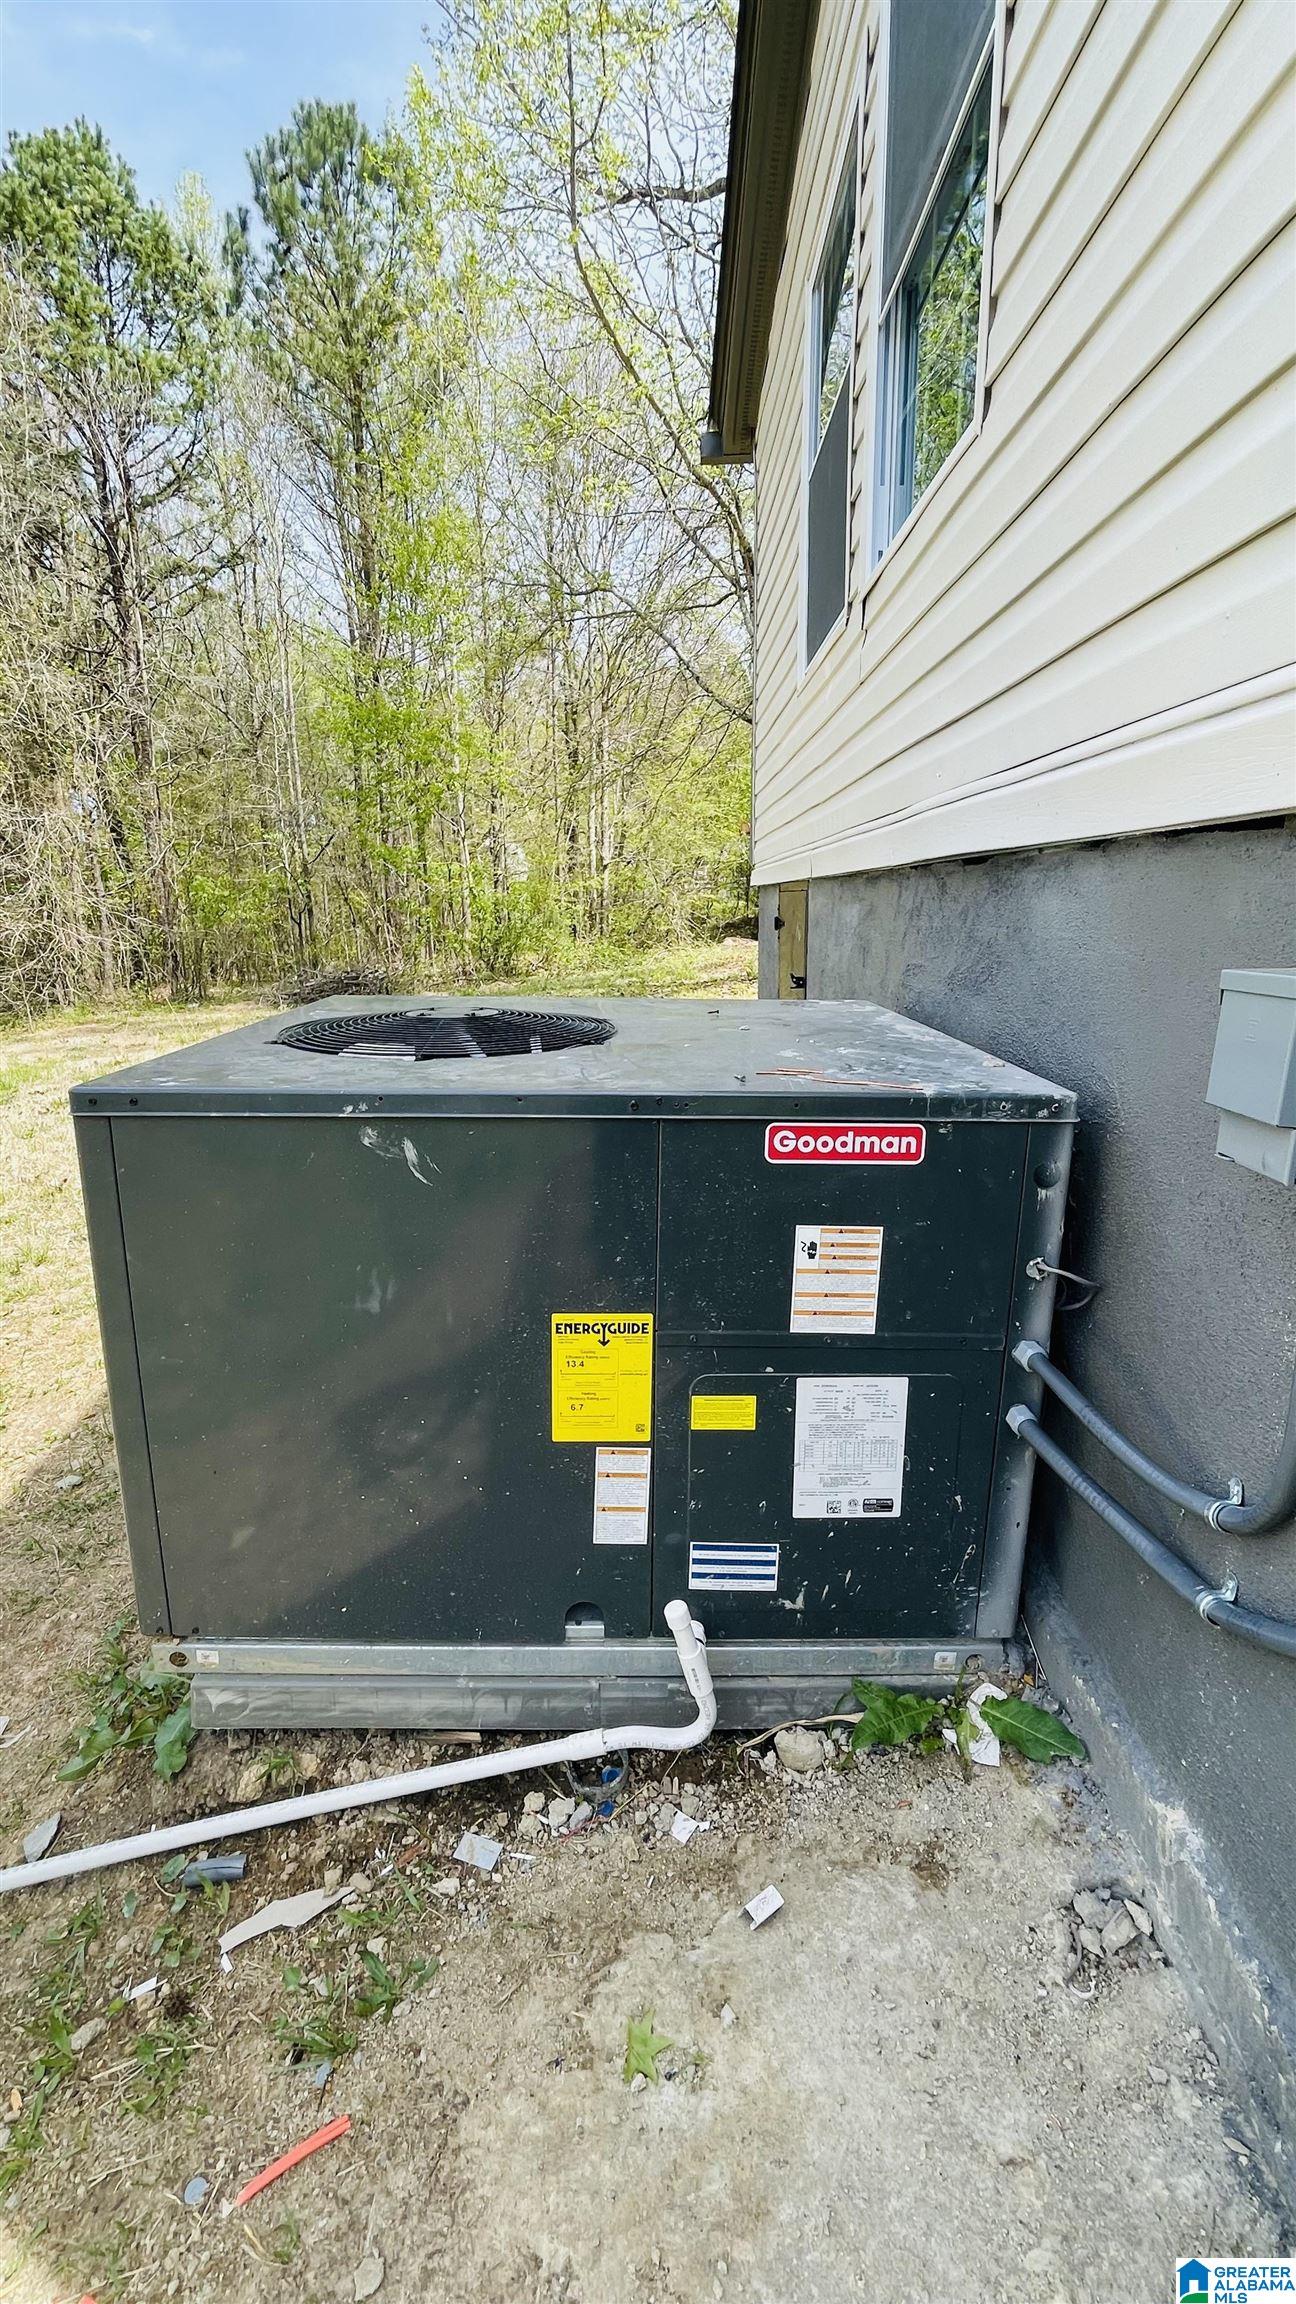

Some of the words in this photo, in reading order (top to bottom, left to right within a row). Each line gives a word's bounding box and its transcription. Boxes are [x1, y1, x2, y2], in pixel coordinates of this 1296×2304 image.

[773, 1130, 917, 1154] Goodman
[555, 1322, 650, 1336] ENERGYGUIDE
[566, 1360, 585, 1368] 13.4
[570, 1403, 584, 1411] 6.7
